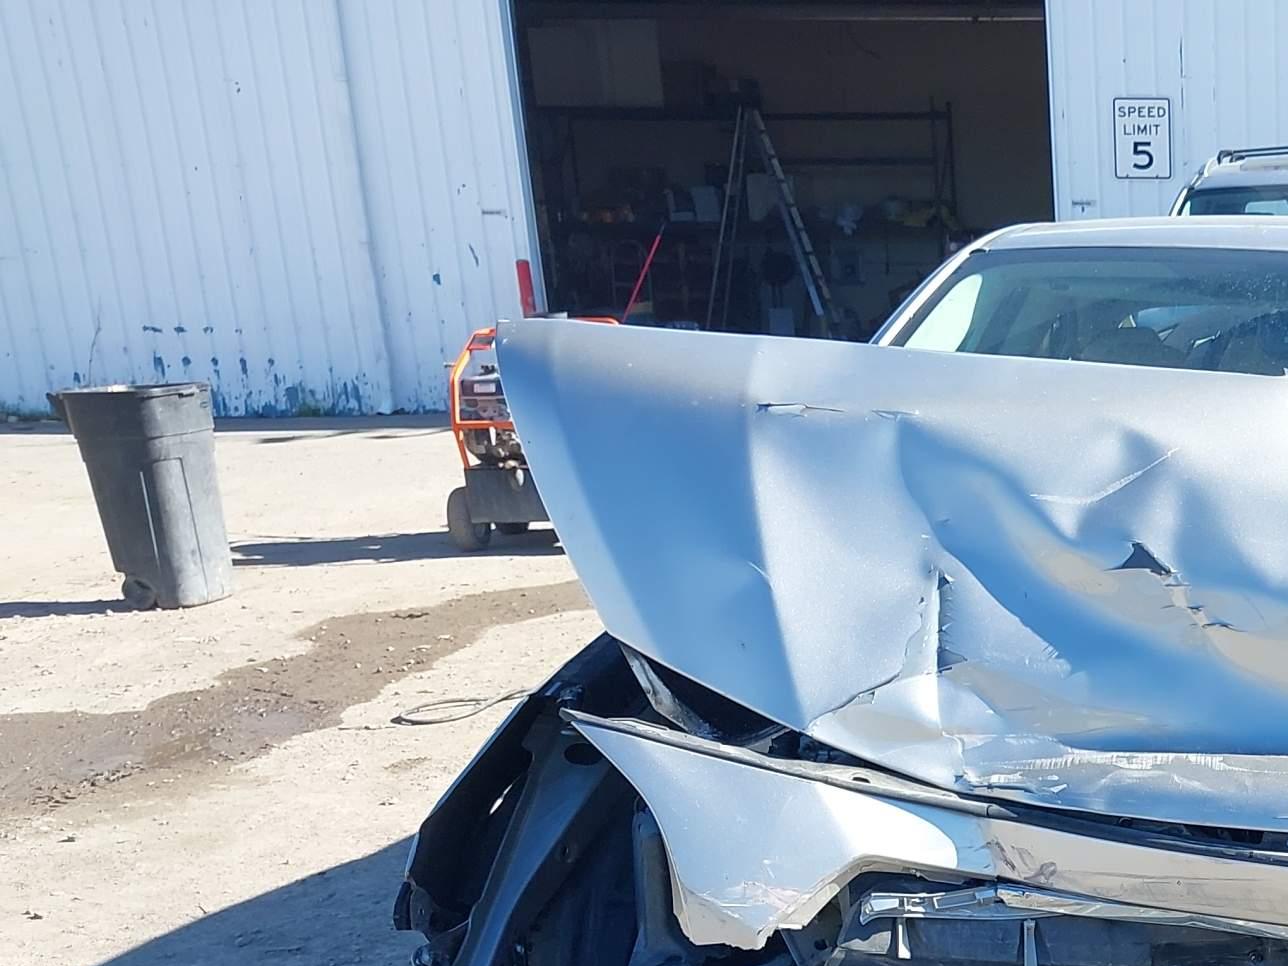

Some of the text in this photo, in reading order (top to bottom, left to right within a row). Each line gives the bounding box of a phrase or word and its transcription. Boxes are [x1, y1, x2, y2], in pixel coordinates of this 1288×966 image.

[1118, 106, 1166, 118] SPEED
[1123, 124, 1160, 136] LIMIT
[1132, 141, 1154, 170] 5
